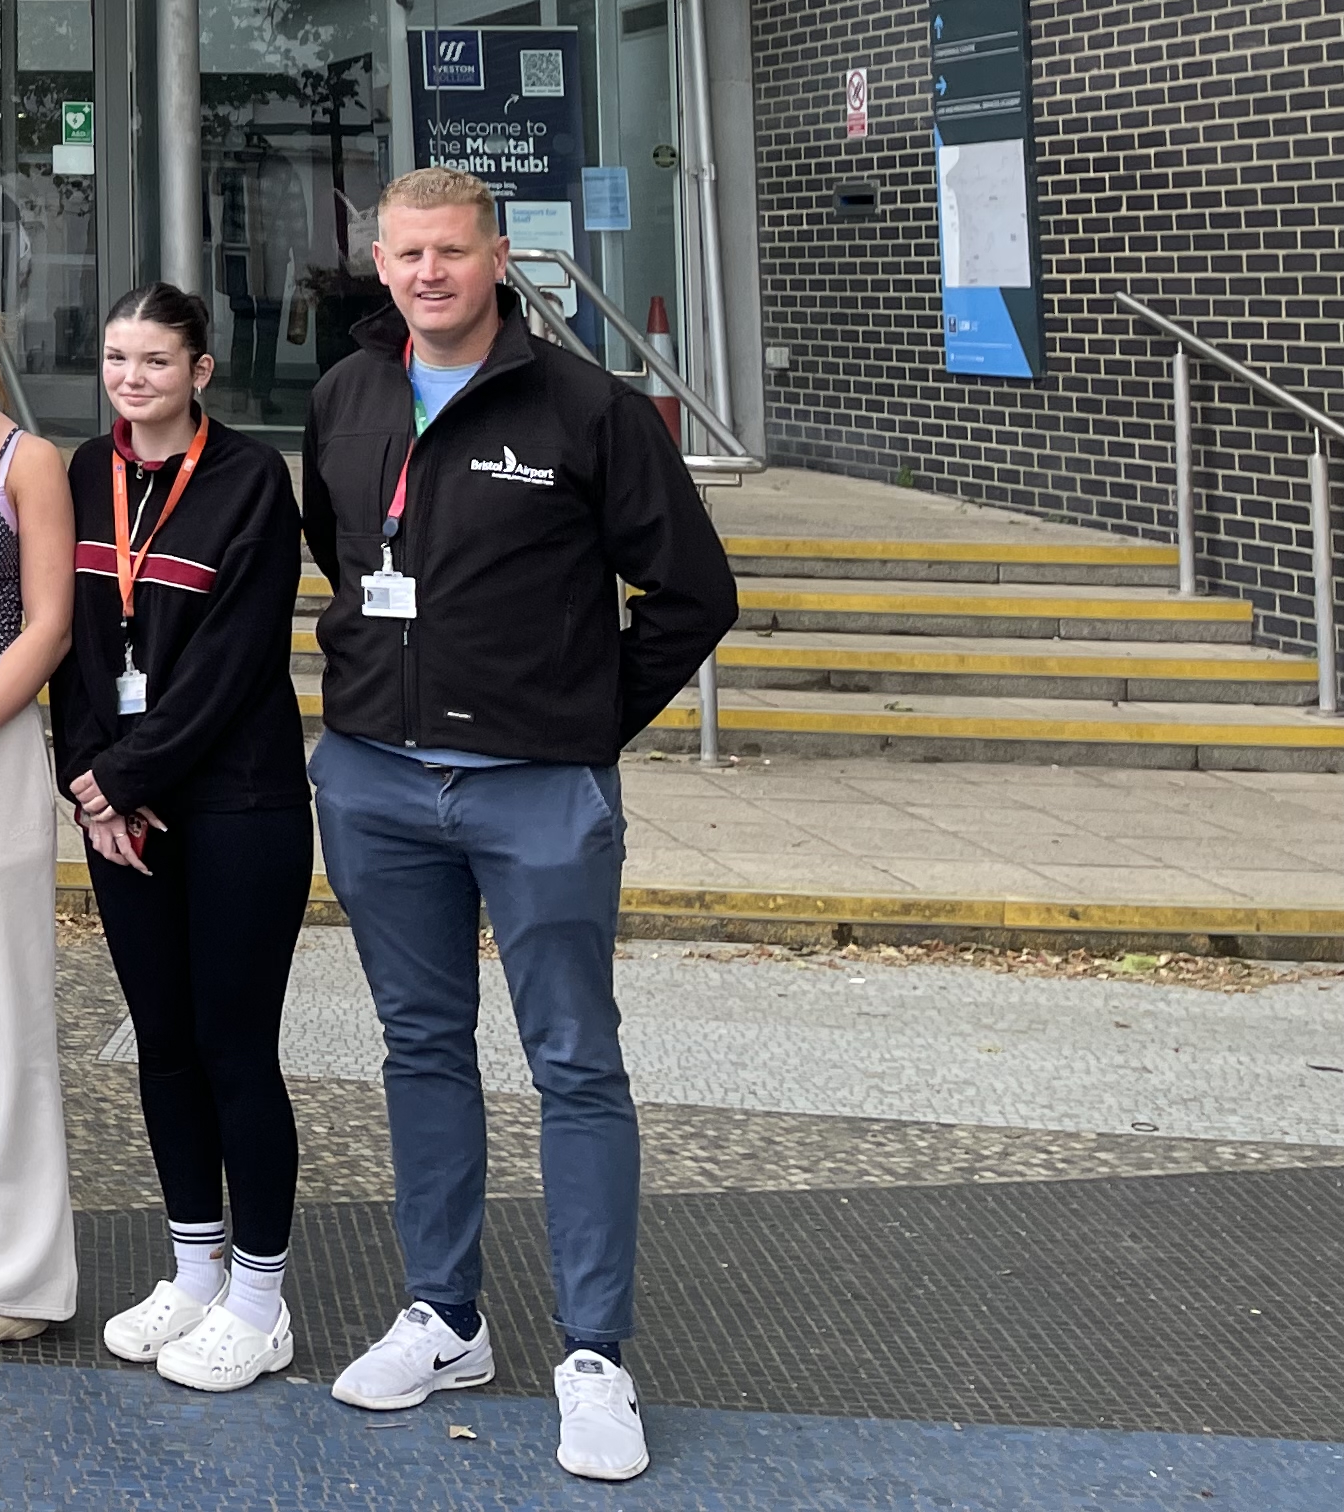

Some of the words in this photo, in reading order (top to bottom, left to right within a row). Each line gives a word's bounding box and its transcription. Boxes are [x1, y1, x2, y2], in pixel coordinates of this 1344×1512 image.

[432, 64, 475, 74] WESTON
[427, 118, 521, 136] Welcome
[526, 119, 547, 136] to
[429, 138, 461, 154] the
[466, 137, 535, 154] Mtal
[430, 155, 496, 173] Health
[500, 155, 549, 173] Hub!
[470, 459, 503, 471] Bristol
[514, 463, 554, 478] Airport
